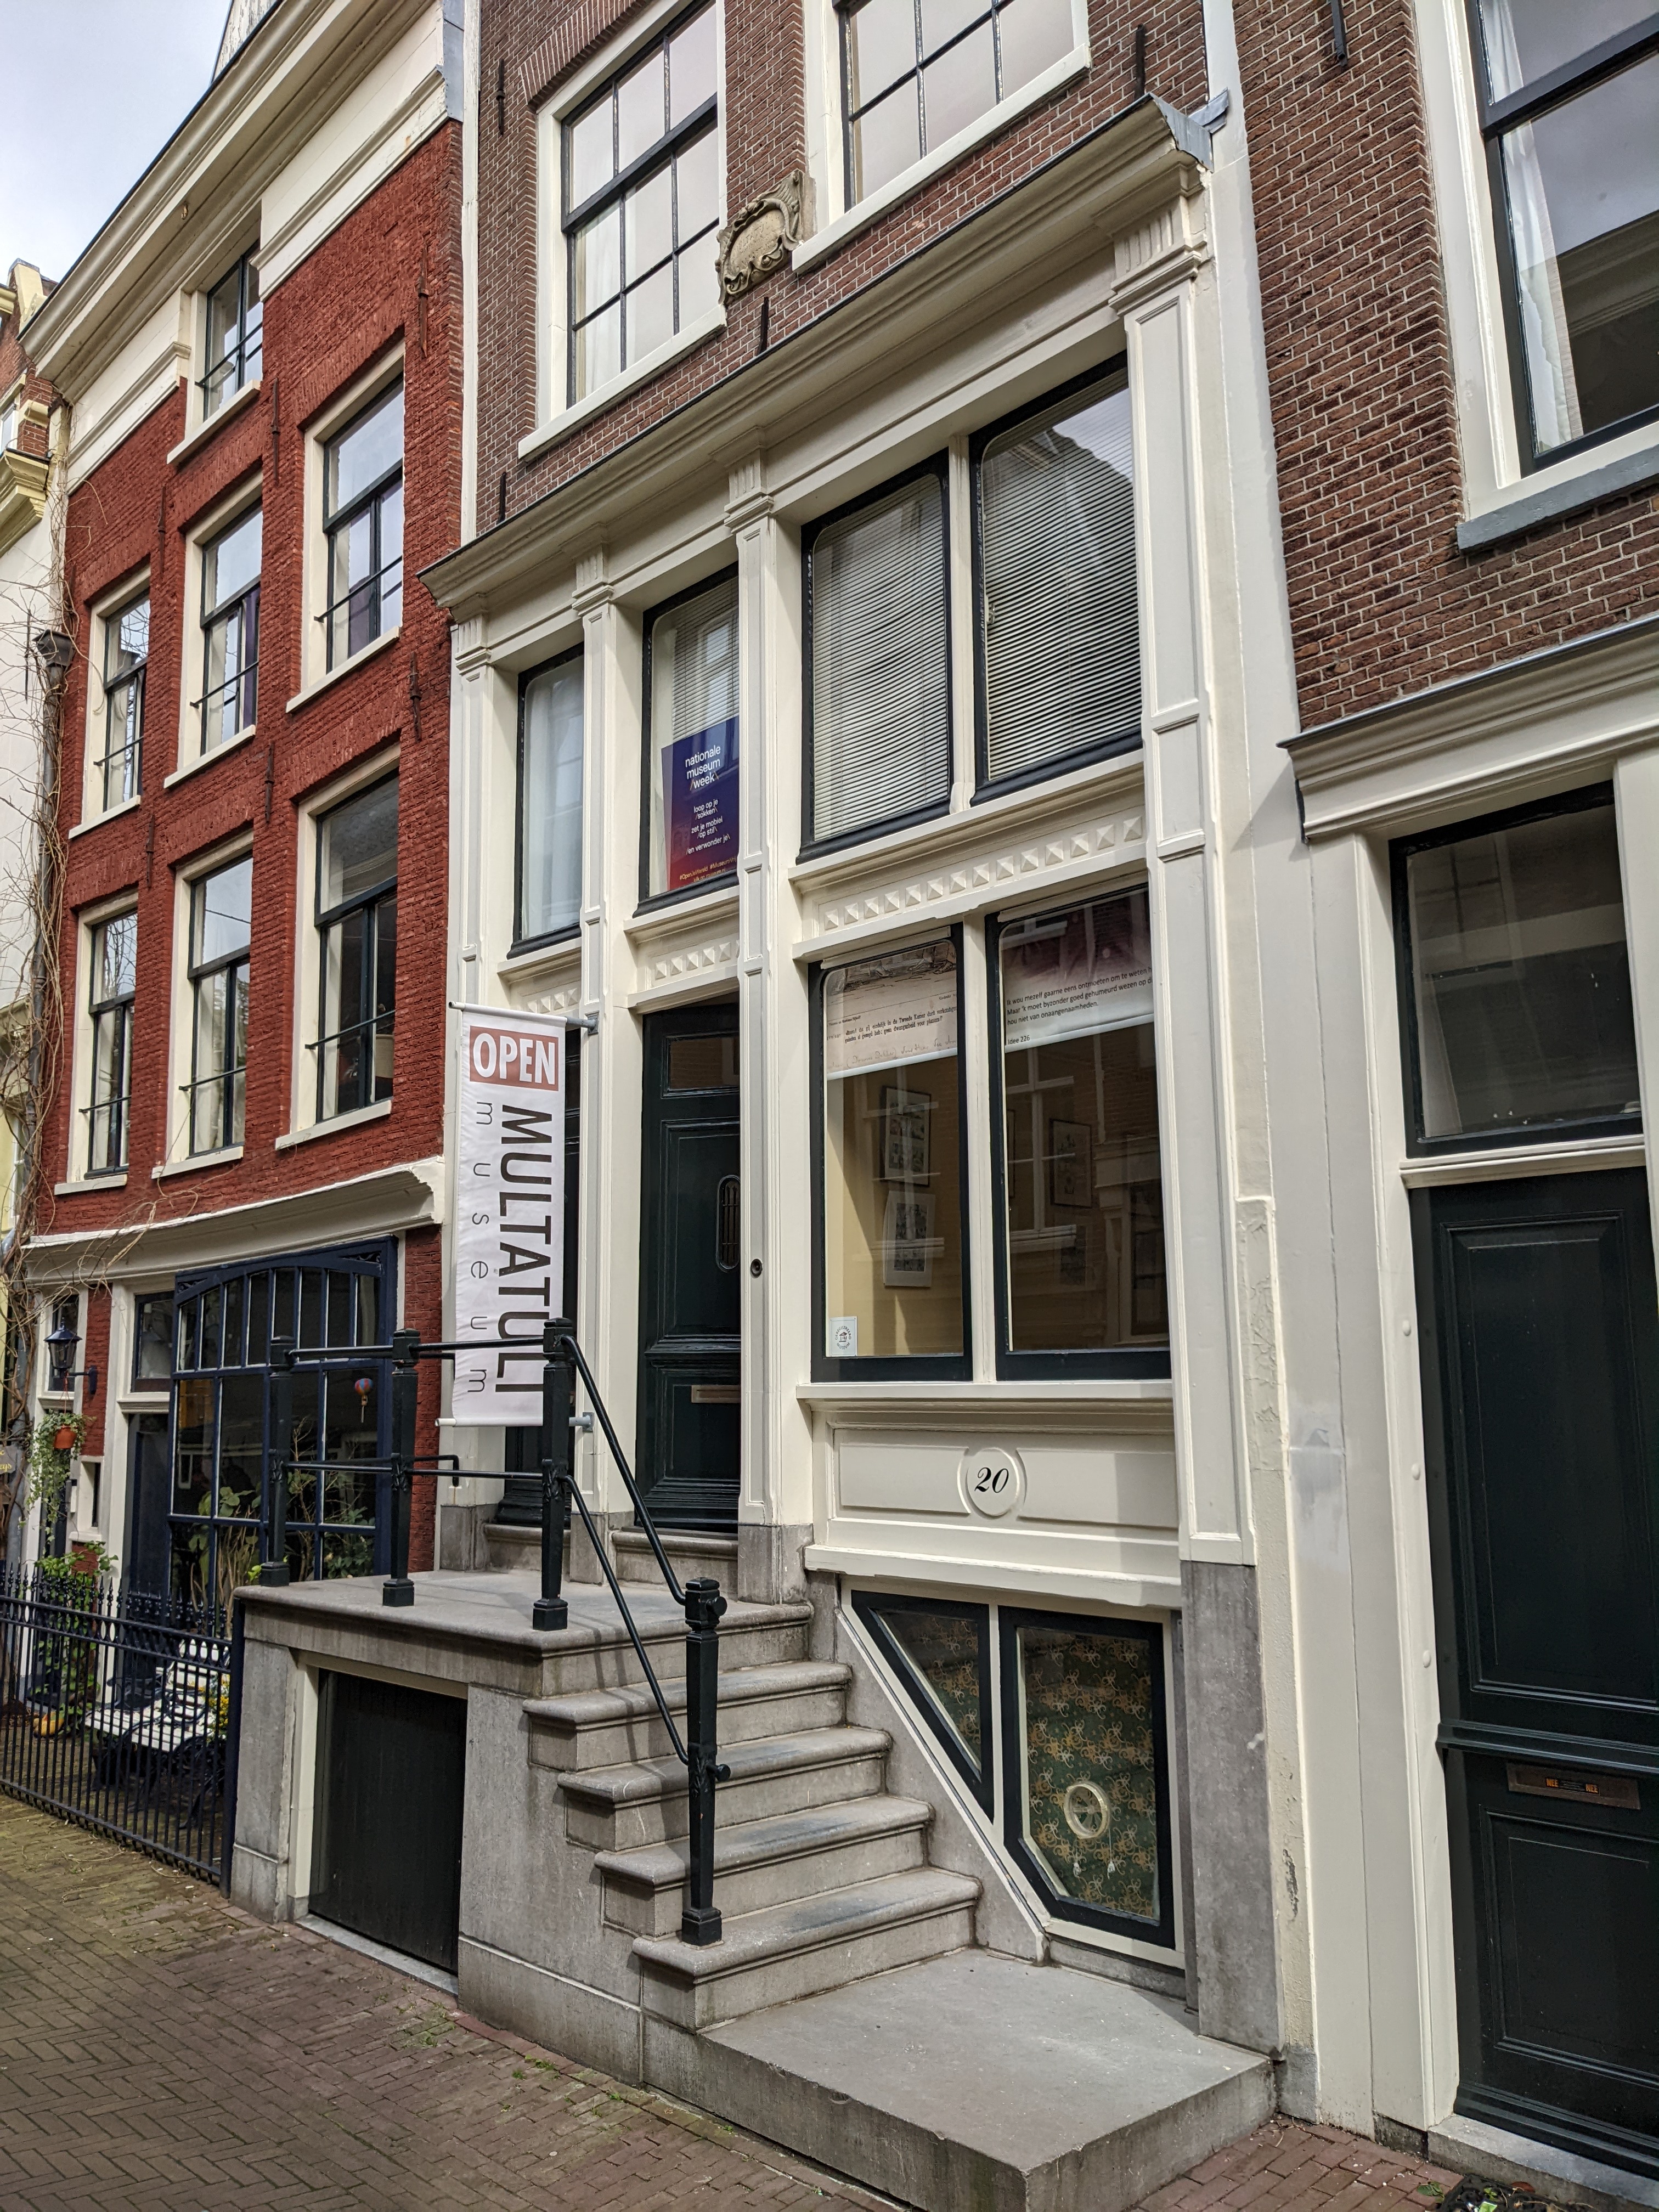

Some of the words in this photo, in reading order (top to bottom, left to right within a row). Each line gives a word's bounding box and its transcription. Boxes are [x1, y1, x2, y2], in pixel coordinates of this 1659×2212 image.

[685, 744, 721, 768] nationale
[687, 759, 720, 780] museum
[693, 804, 704, 813] loop
[713, 799, 718, 808] je
[700, 823, 704, 832] je
[706, 816, 723, 828] mobiel
[695, 837, 722, 851] verwonder
[1024, 991, 1043, 1001] mezelf
[1044, 989, 1063, 998] gaarne
[1078, 978, 1109, 989] ontmoeten
[1129, 968, 1147, 977] weten
[1043, 997, 1069, 1008] byzonder
[1070, 993, 1084, 1003] goed
[1085, 985, 1118, 1000] gehumeurd
[1118, 981, 1137, 990] wezen
[1041, 1001, 1099, 1018] onaangenaamheden.
[473, 1032, 555, 1085] OPEN
[467, 1102, 493, 1392] museum
[495, 1104, 552, 1392] MULTATULI
[974, 1467, 1009, 1493] 20
[1546, 1778, 1559, 1787] NEE
[1585, 1784, 1598, 1793] NEE
